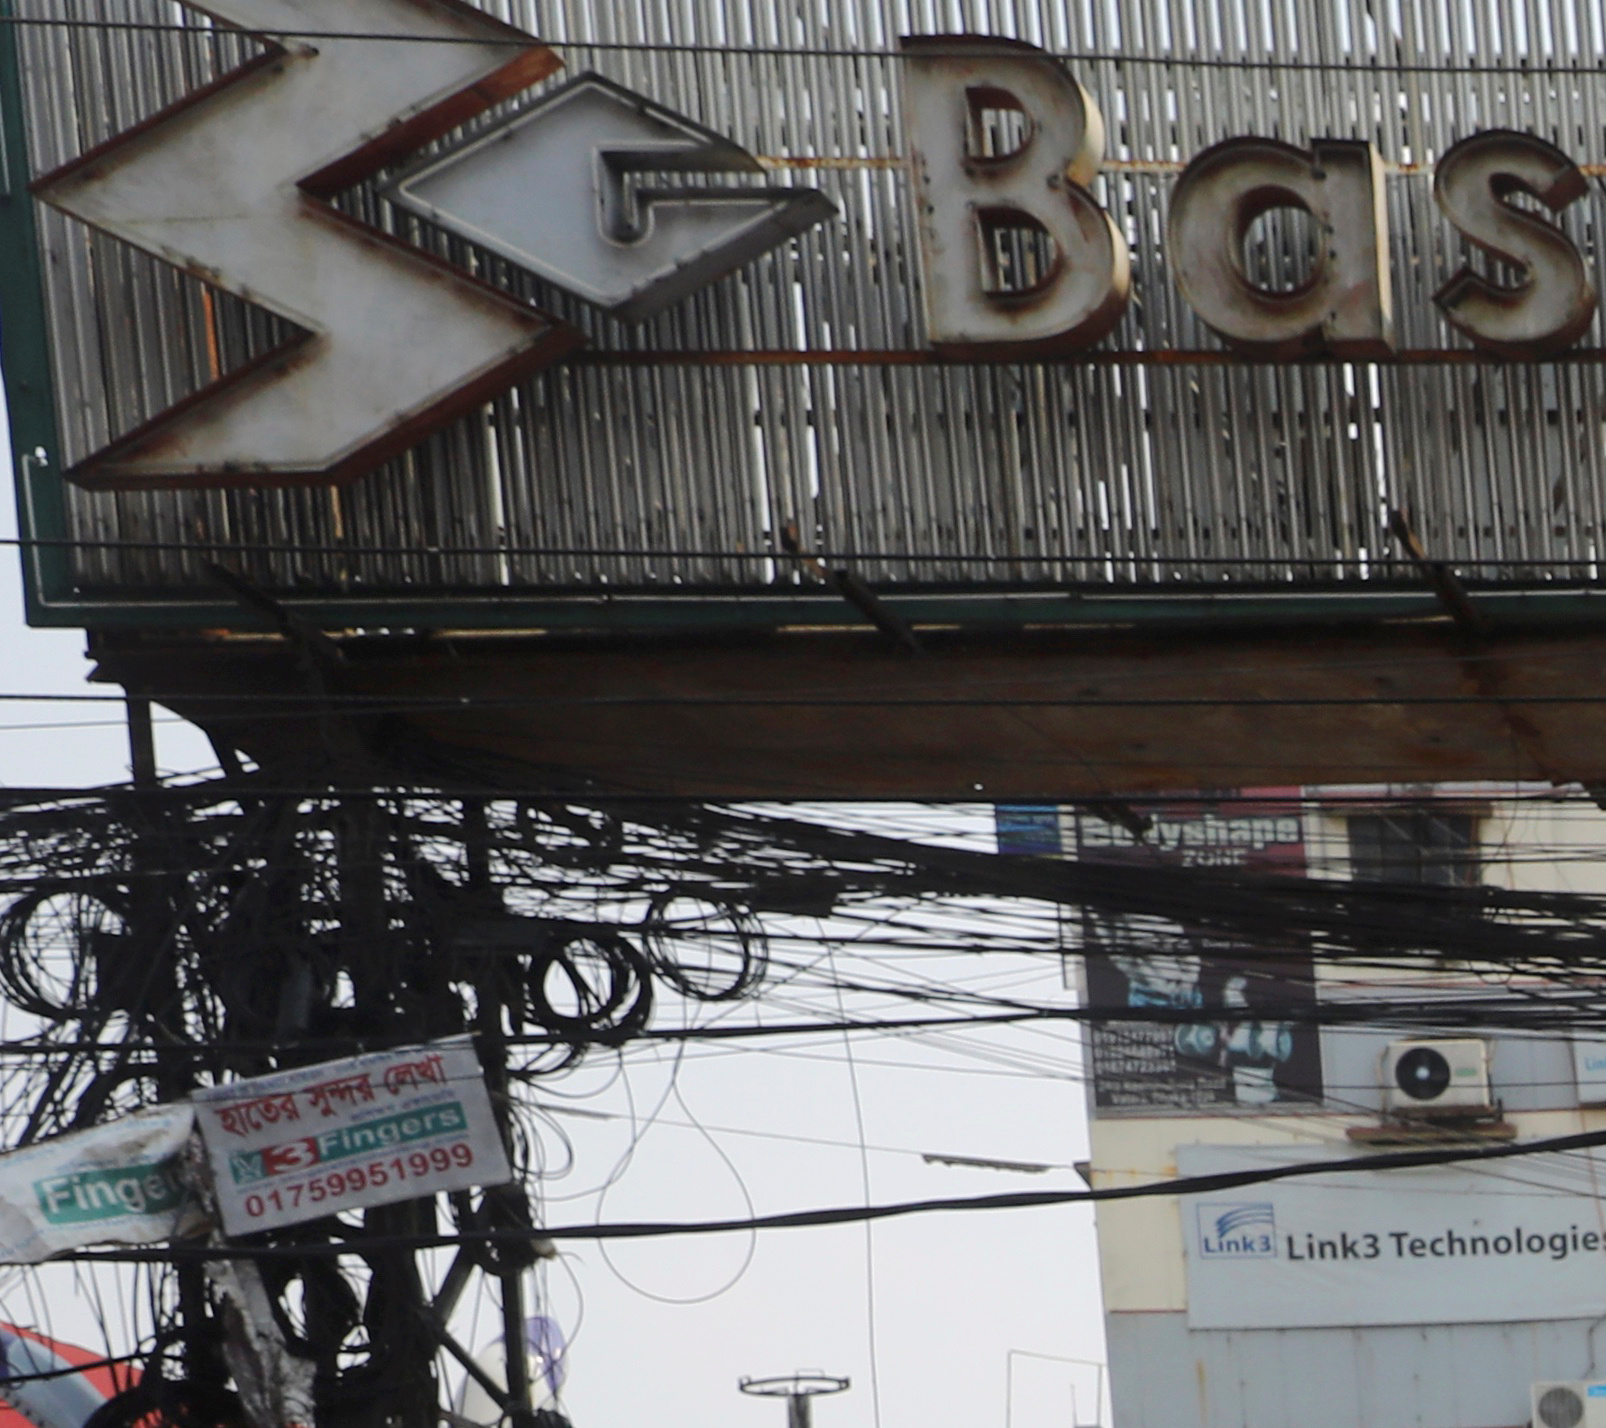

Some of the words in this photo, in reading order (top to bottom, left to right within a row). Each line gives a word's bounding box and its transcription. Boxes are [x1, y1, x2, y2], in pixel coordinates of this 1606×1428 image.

[246, 1142, 475, 1219] 01759951999
[1203, 1235, 1272, 1255] Link3
[1285, 1232, 1382, 1263] Link3
